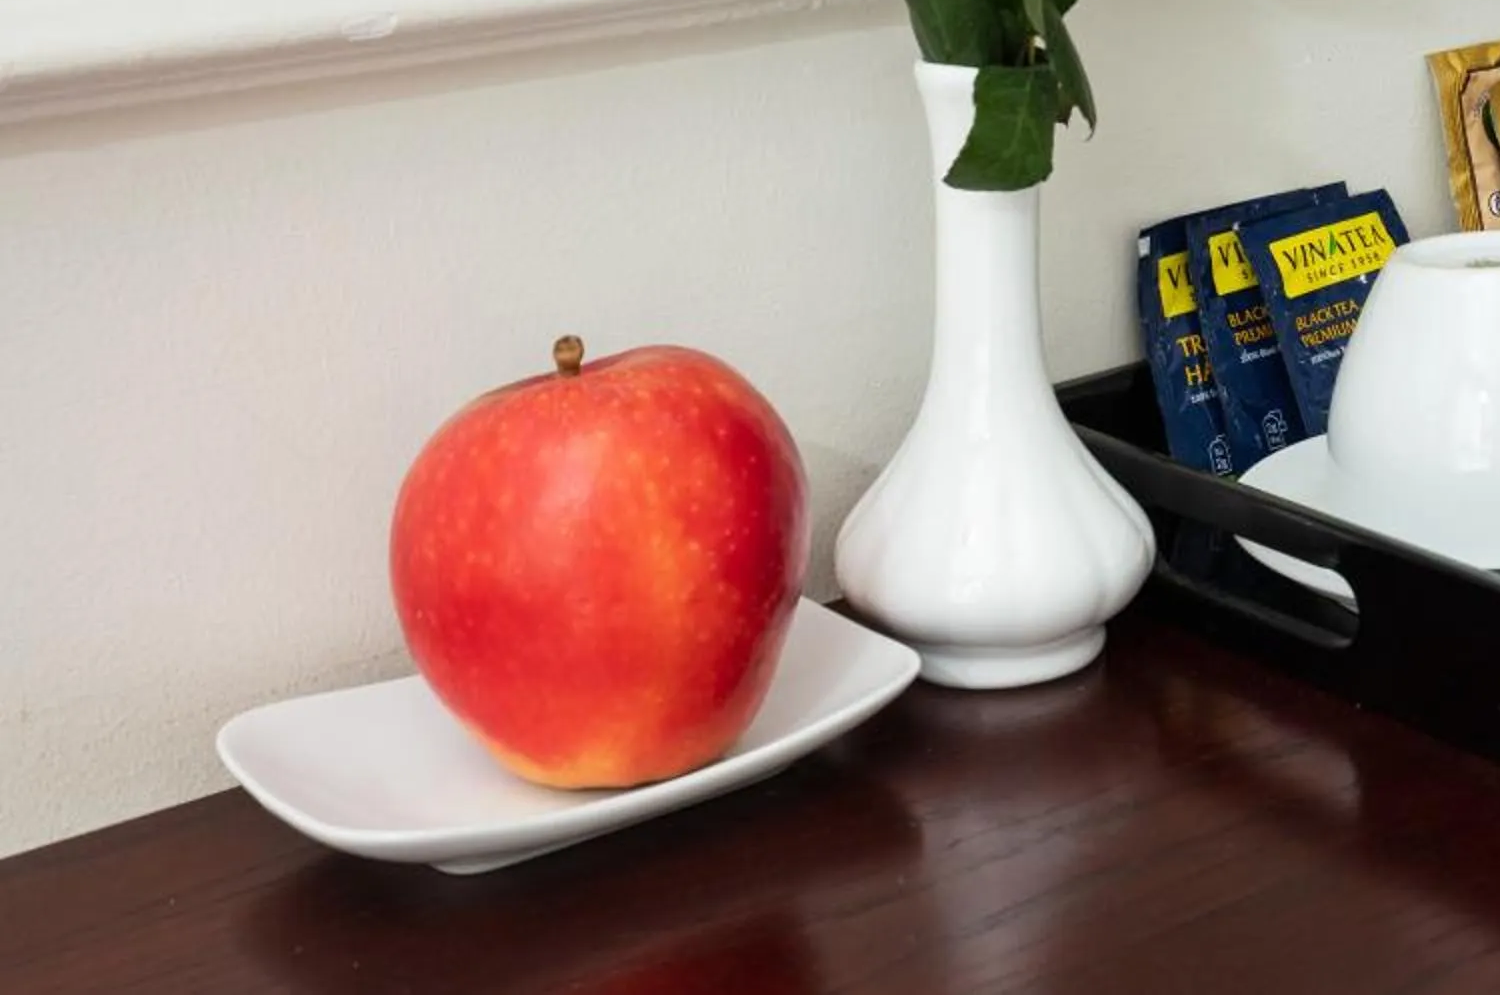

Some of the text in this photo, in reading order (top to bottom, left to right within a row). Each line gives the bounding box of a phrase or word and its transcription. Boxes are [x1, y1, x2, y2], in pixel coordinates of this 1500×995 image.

[1282, 224, 1386, 271] VINATEA
[1306, 263, 1344, 283] SINCE
[1227, 306, 1268, 327] BLAC
[1295, 306, 1337, 332] BLACK
